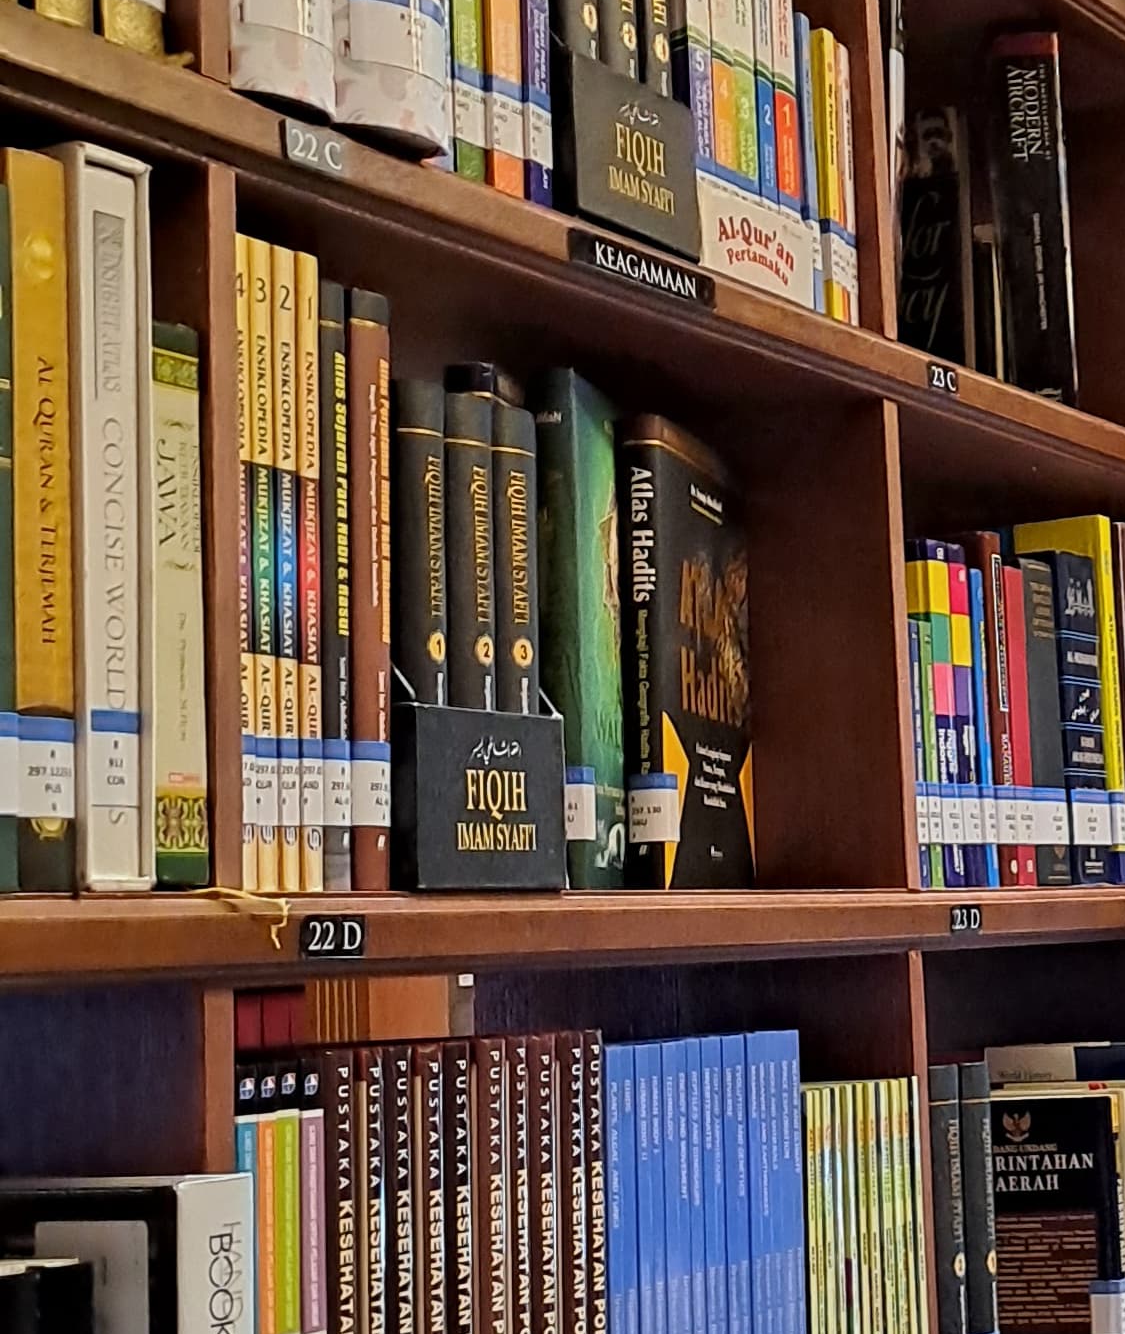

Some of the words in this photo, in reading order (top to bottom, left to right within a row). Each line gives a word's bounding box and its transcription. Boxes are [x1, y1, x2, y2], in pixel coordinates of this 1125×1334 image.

[764, 104, 771, 125] 2
[782, 103, 791, 127] 1
[1006, 66, 1028, 162] AIRCRAFT
[1023, 70, 1043, 154] MODERN
[290, 131, 319, 163] 22
[324, 142, 342, 169] C
[615, 123, 666, 177] FIQIH
[608, 166, 639, 197] IMAM
[256, 278, 267, 302] 3
[595, 241, 697, 298] KEAGAMAAN
[726, 247, 788, 286] Pertamaku
[279, 286, 291, 311] 2
[36, 355, 55, 384] AL
[257, 336, 267, 455] ENSIKLOPEDIA
[932, 366, 945, 386] 23
[947, 372, 957, 391] C
[32, 397, 57, 487] QURAN
[102, 417, 127, 571] CONCISE
[156, 438, 178, 546] JAWA
[258, 467, 269, 554] MUKJIZAT
[631, 467, 654, 523] Atlas
[40, 522, 57, 644] TERJEMAH
[632, 530, 656, 603] Hadits
[260, 578, 270, 654] KHASIAT
[104, 583, 126, 710] WORLD
[436, 639, 442, 655] 1
[483, 643, 490, 657] 2
[520, 645, 527, 659] 3
[466, 769, 527, 820] FIQIH
[457, 822, 494, 851] IMAM
[308, 922, 335, 951] 22
[342, 920, 361, 949] D
[952, 910, 967, 930] 23
[969, 908, 980, 929] D
[337, 1066, 349, 1190] PUSTAKA
[396, 1060, 408, 1180] PUSTAKA
[489, 1050, 500, 1165] PUSTAKA
[540, 1054, 550, 1164] PUSTAKA
[995, 1153, 1094, 1172] RINTAHAN
[995, 1173, 1059, 1192] AERAH
[396, 1190, 411, 1331] KESEHATAN
[490, 1174, 505, 1312] KESEHATAN
[541, 1172, 555, 1304] KESEHATAN
